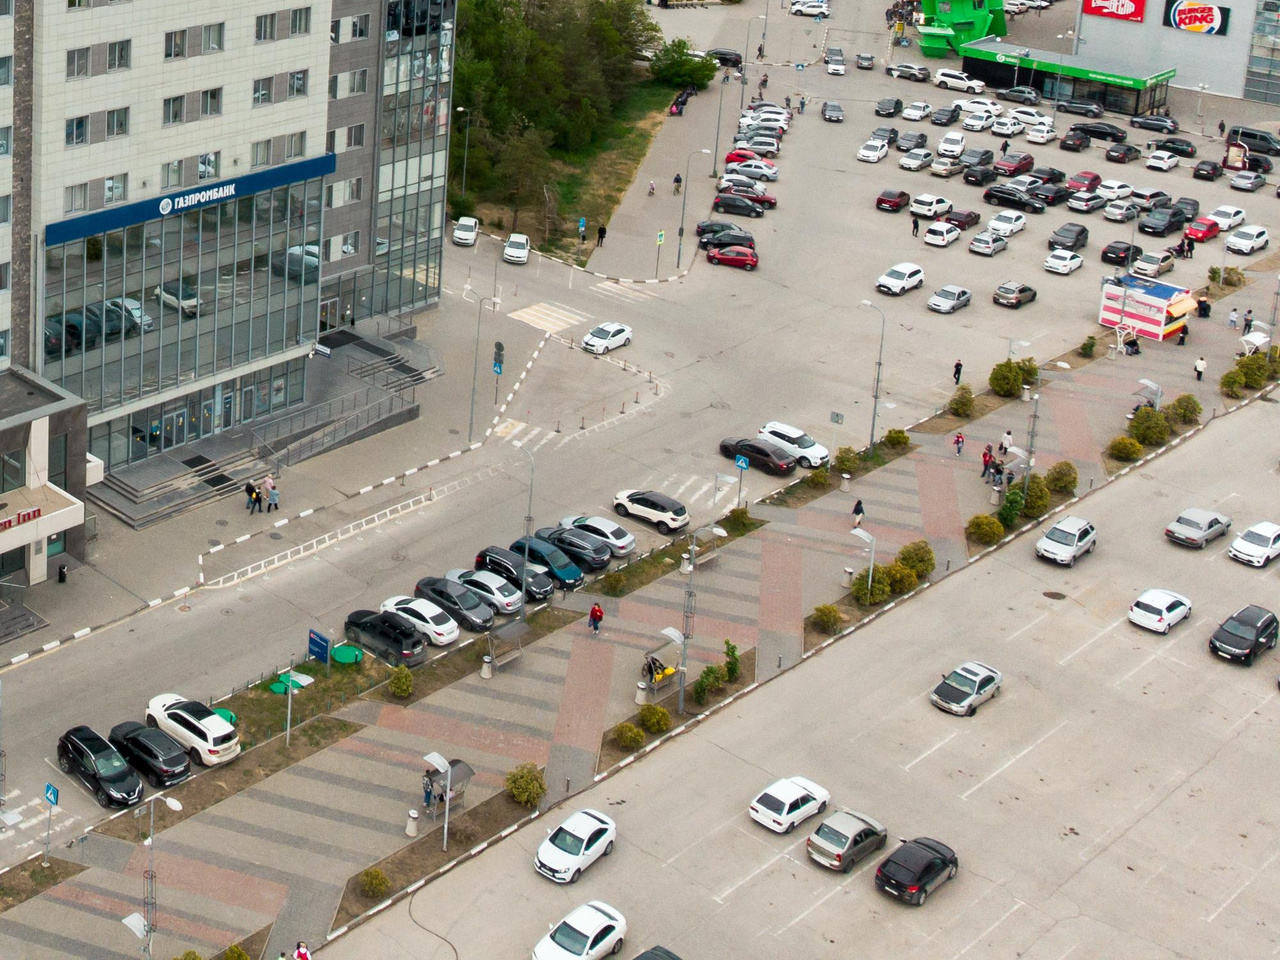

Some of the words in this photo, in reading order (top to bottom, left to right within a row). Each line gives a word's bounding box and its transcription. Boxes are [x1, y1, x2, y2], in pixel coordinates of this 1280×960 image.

[1177, 6, 1214, 17] BURGER
[1178, 13, 1215, 27] KING
[174, 183, 235, 209] ГАЗПРОМБАНК
[16, 507, 42, 525] Inn
